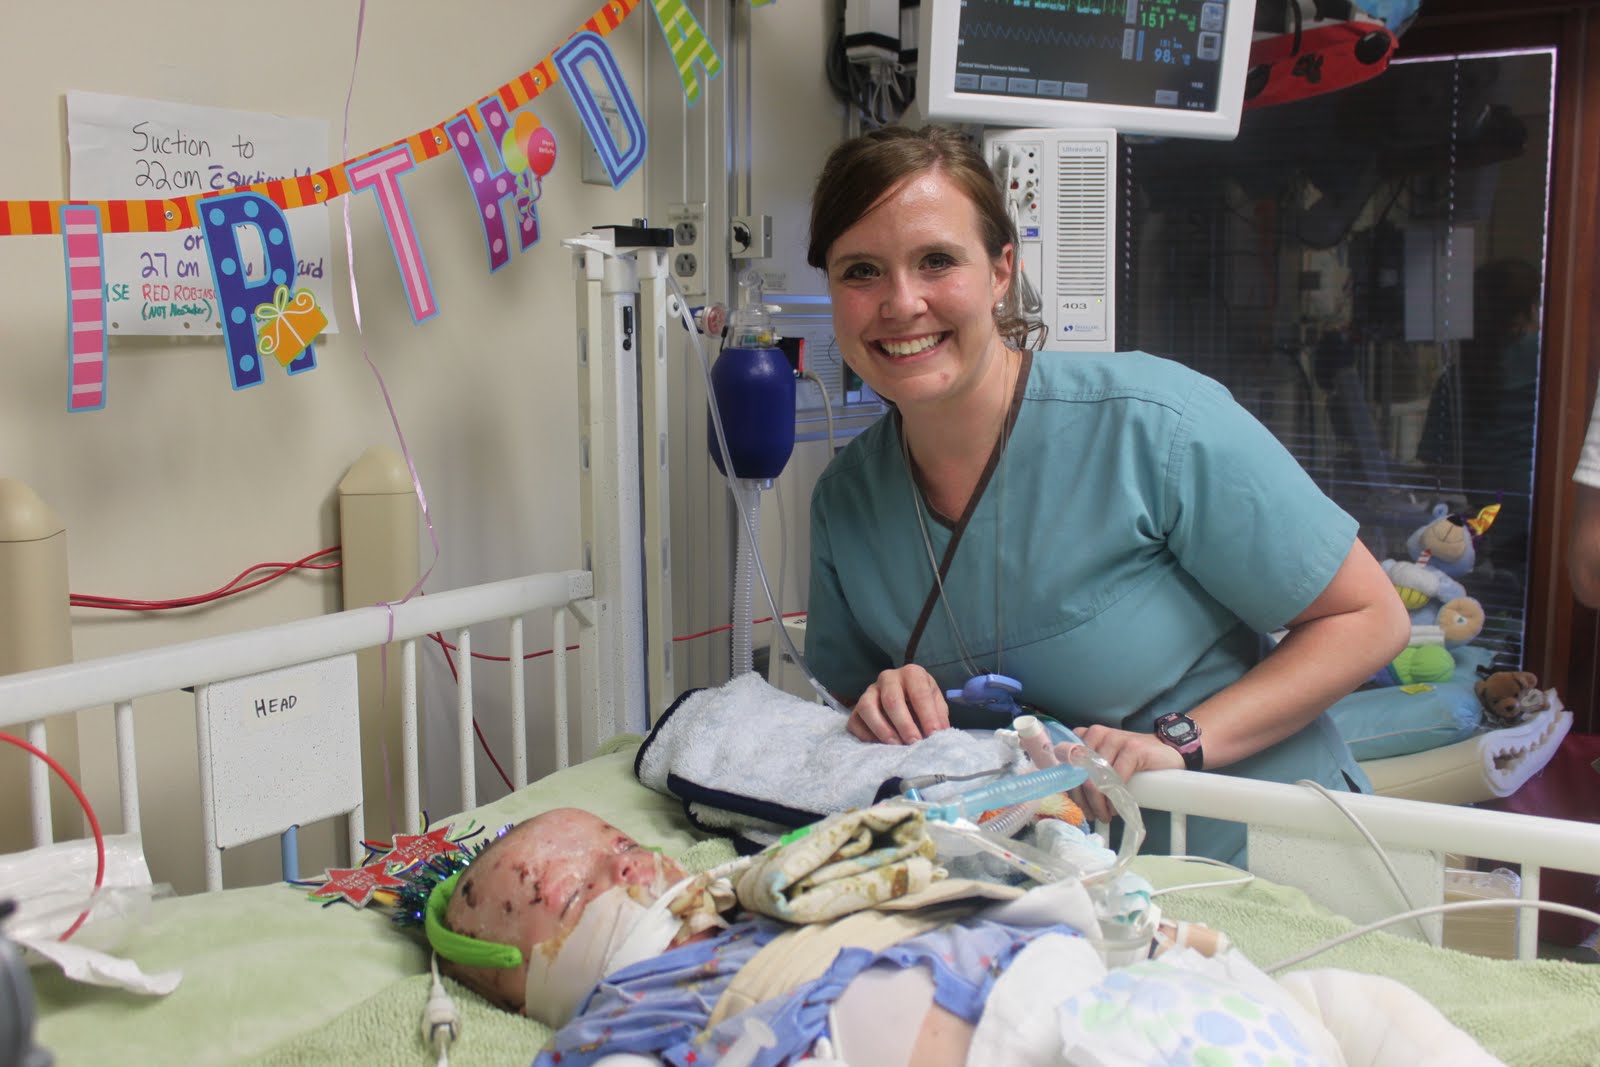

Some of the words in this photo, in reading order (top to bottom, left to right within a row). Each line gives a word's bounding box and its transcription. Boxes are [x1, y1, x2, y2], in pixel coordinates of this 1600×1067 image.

[132, 121, 211, 158] Suction
[232, 134, 255, 159] to
[140, 252, 169, 278] 27
[177, 259, 200, 278] cm
[142, 283, 170, 303] RED
[174, 284, 216, 301] ROBINS
[254, 694, 298, 718] HEAD
